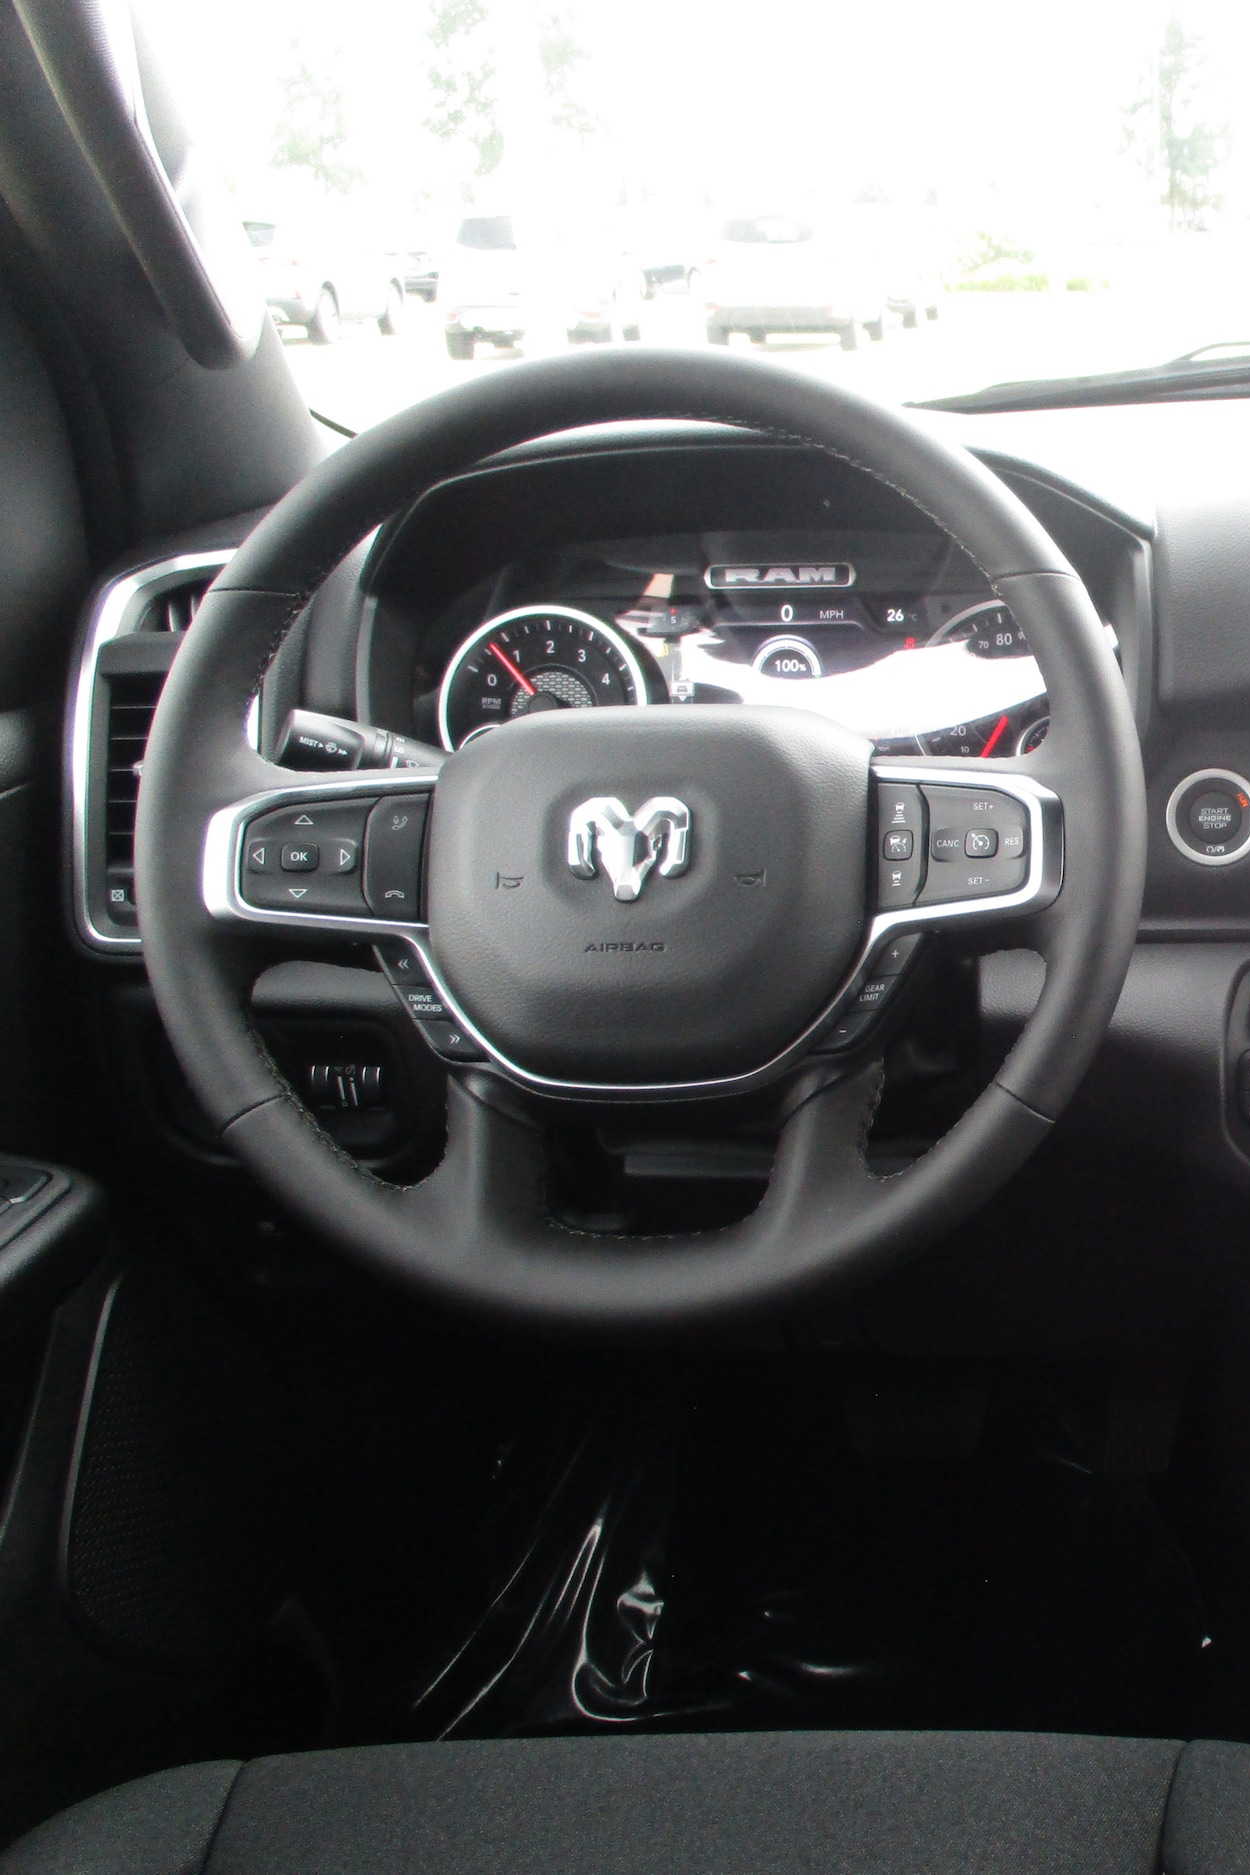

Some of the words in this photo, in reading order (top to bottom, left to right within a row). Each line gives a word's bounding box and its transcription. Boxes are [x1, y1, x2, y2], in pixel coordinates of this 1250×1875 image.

[724, 566, 836, 584] RAM
[780, 604, 794, 623] 0
[819, 610, 844, 620] MPH
[887, 608, 904, 622] 26
[995, 633, 1012, 646] 80
[546, 640, 555, 654] 2
[978, 641, 989, 649] 70
[513, 651, 520, 662] 1
[578, 650, 587, 662] 3
[775, 659, 807, 672] 100%
[487, 674, 497, 687] 0
[602, 673, 611, 685] 4
[950, 726, 967, 736] 20
[299, 736, 318, 748] MIST
[960, 746, 970, 754] 10
[1200, 807, 1229, 815] START
[1203, 822, 1228, 830] STOP
[936, 839, 960, 848] CANC
[1004, 837, 1020, 846] RES
[289, 851, 309, 863] OK
[584, 943, 667, 953] AIRBAG
[864, 983, 885, 993] GEAR
[408, 994, 433, 1003] DRIVE
[859, 993, 880, 1001] LIMIT
[413, 1003, 443, 1012] MODES
